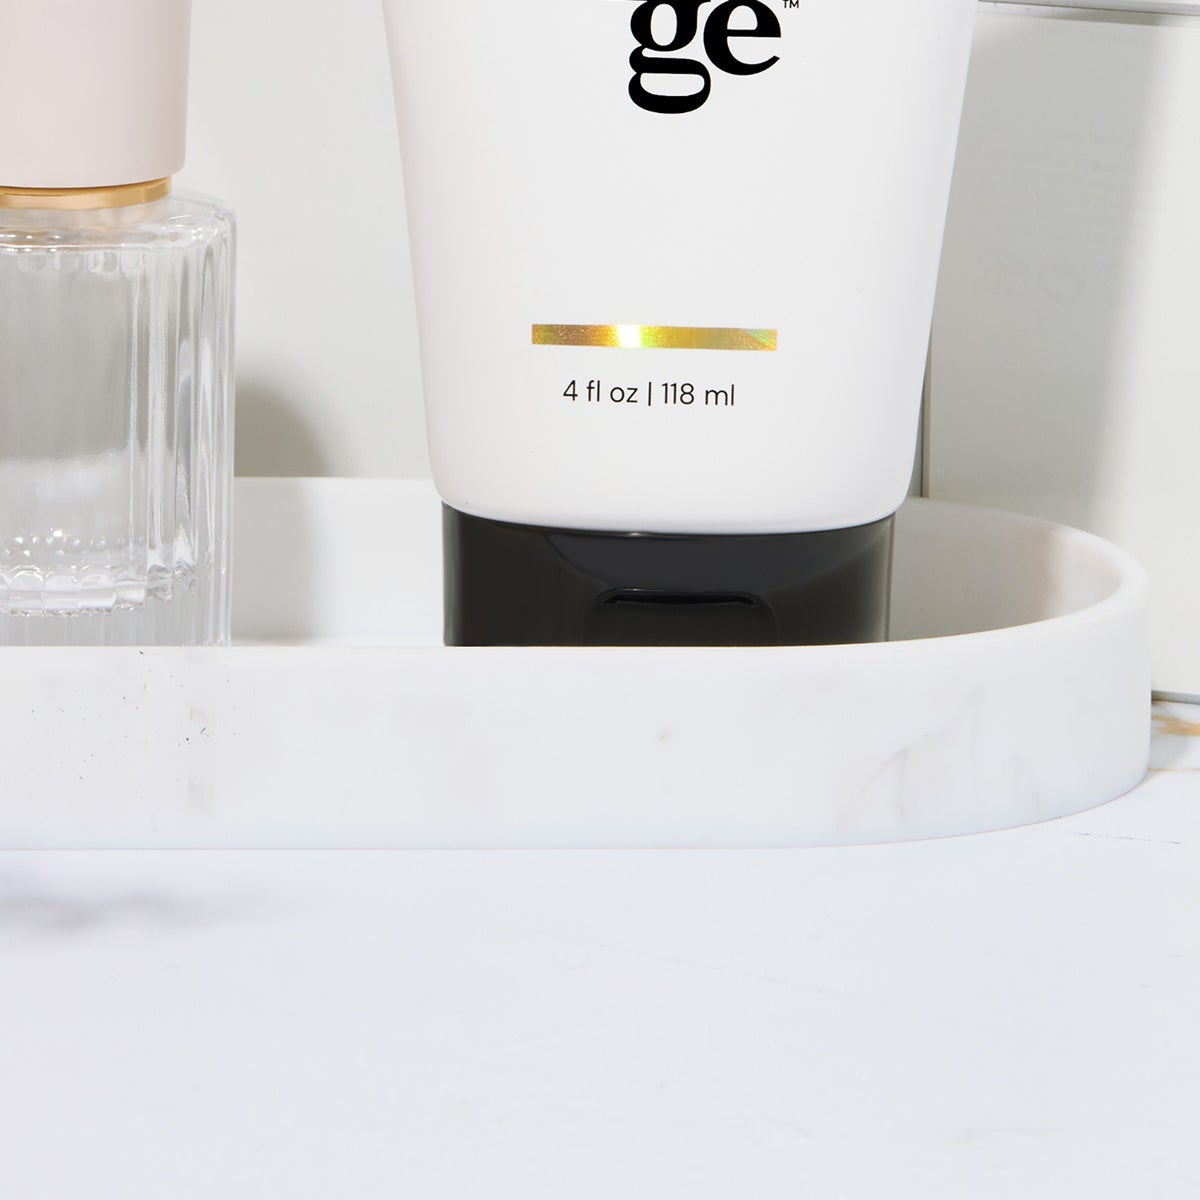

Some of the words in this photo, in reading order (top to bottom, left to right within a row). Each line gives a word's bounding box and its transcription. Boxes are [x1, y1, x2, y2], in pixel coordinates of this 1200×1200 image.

[562, 379, 579, 402] 4
[586, 379, 601, 402] fl
[609, 386, 639, 404] oz
[661, 382, 695, 405] 118
[704, 383, 735, 406] ml
